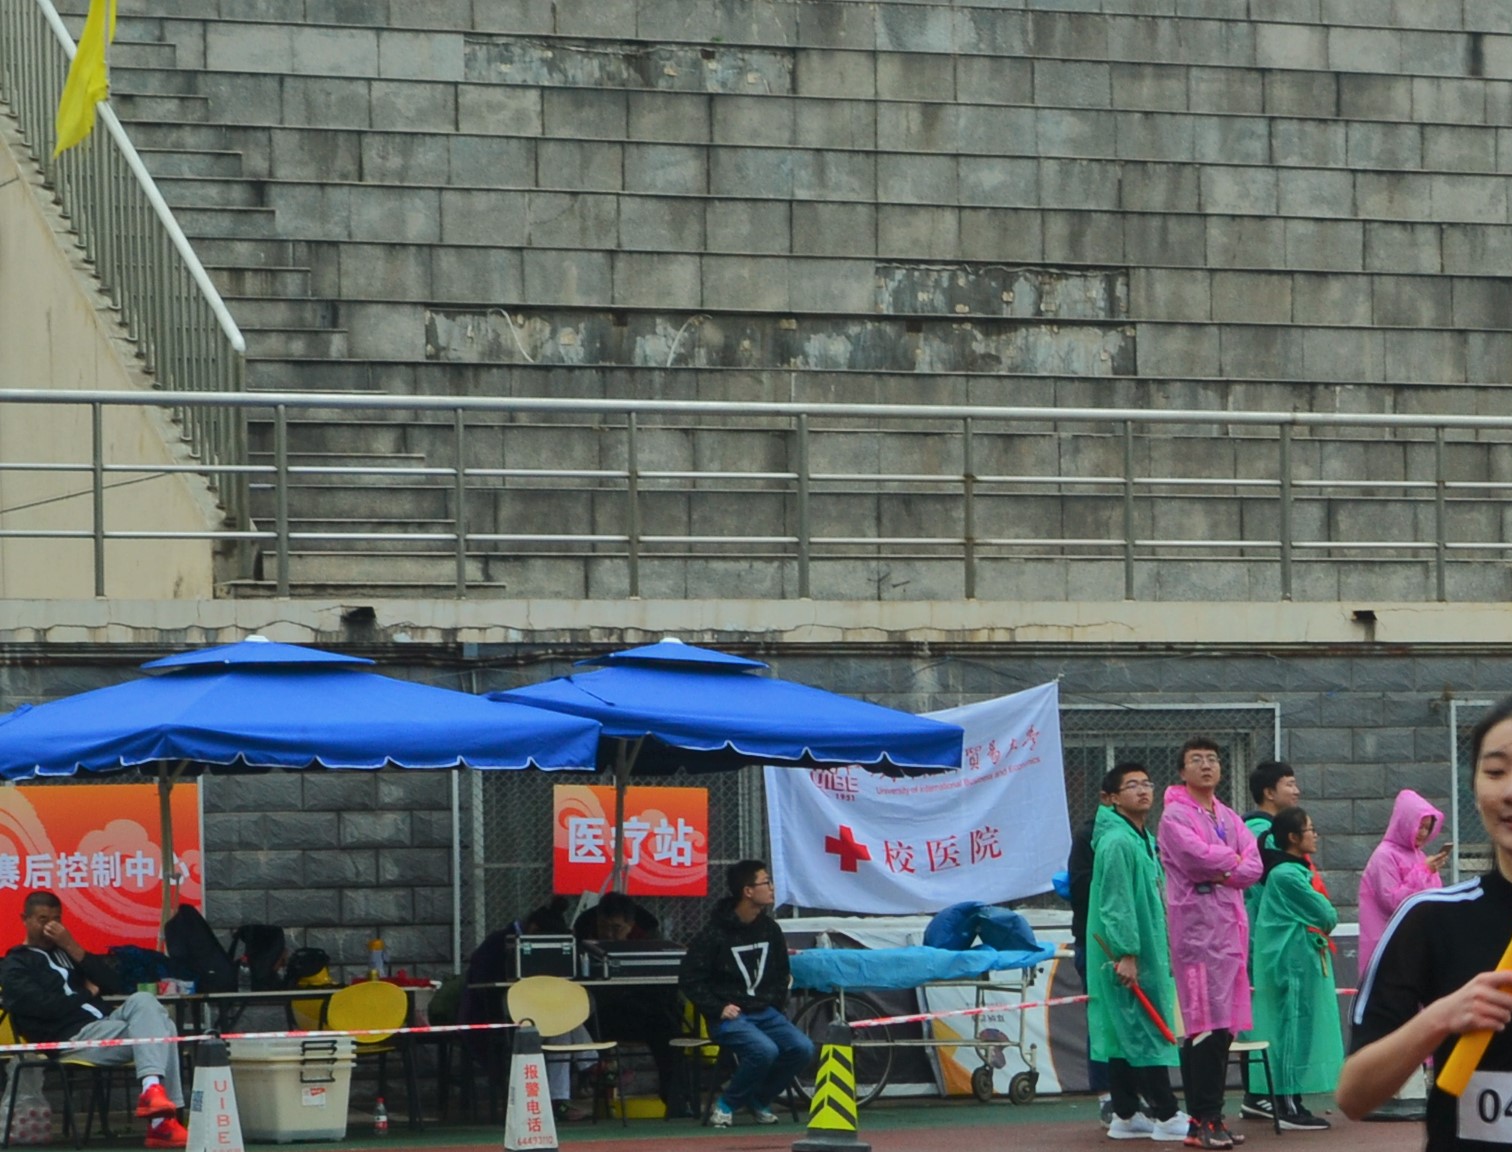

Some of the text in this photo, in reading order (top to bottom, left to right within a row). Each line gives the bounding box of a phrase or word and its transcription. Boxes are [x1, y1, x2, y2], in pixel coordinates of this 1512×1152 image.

[568, 815, 695, 867] 医疗站
[882, 824, 1003, 874] 校医院
[213, 1080, 231, 1144] UIBE
[523, 1063, 542, 1132] 报警电话
